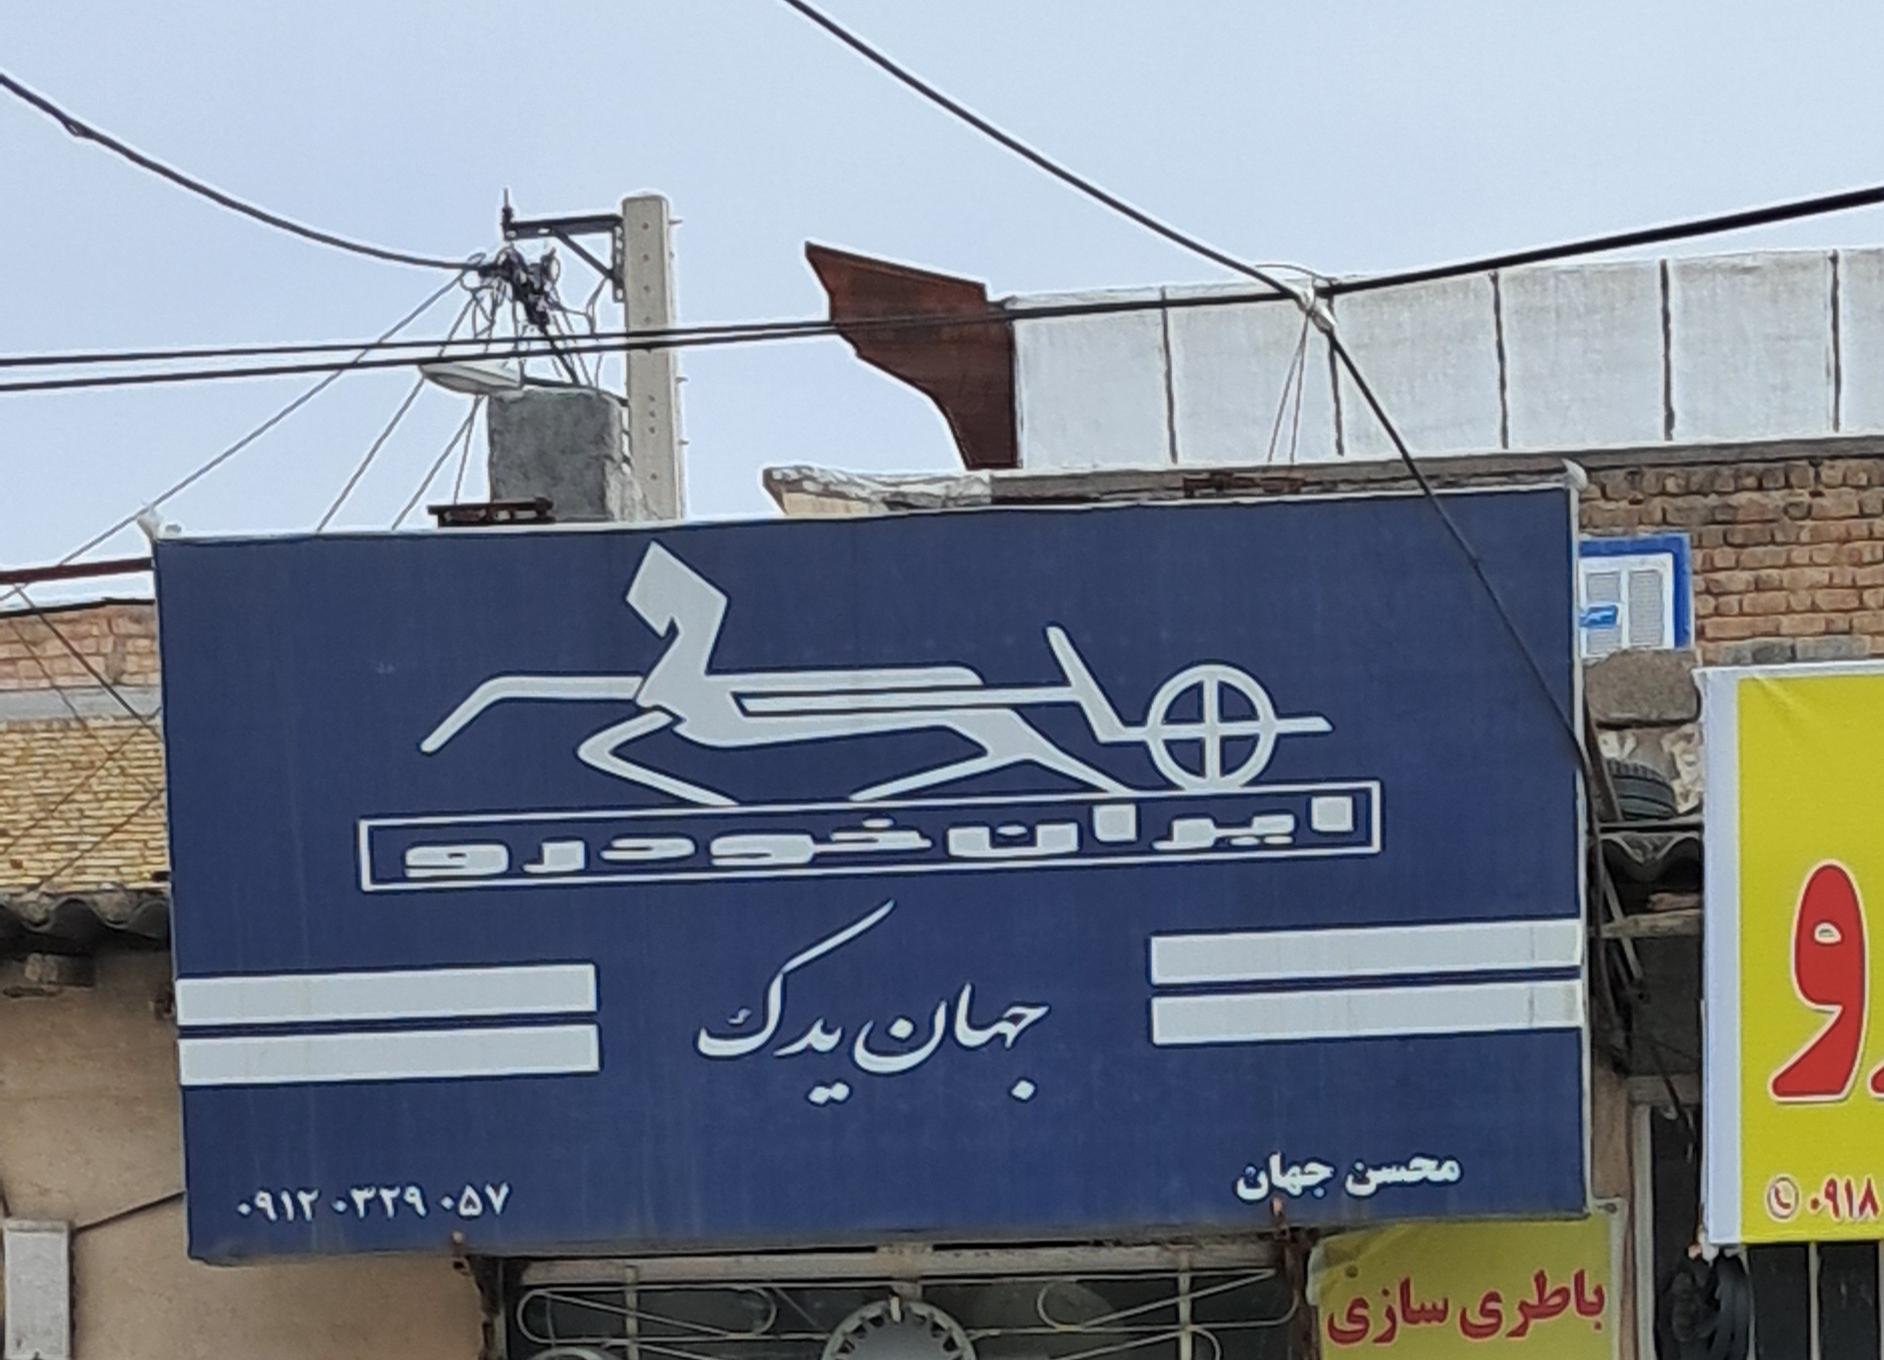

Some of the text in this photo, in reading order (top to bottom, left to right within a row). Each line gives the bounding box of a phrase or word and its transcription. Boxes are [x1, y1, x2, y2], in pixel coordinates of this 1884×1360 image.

[403, 794, 1354, 879] ایران خودرو
[697, 899, 1050, 1104] جهان یدک
[237, 1188, 320, 1221] ۰۹۱۲
[440, 1182, 510, 1216] ۰۵۷
[1236, 1151, 1461, 1201] محسن جهان
[1809, 1177, 1881, 1219] ۰۹۱۸
[1325, 1267, 1607, 1345] باطری سازی
